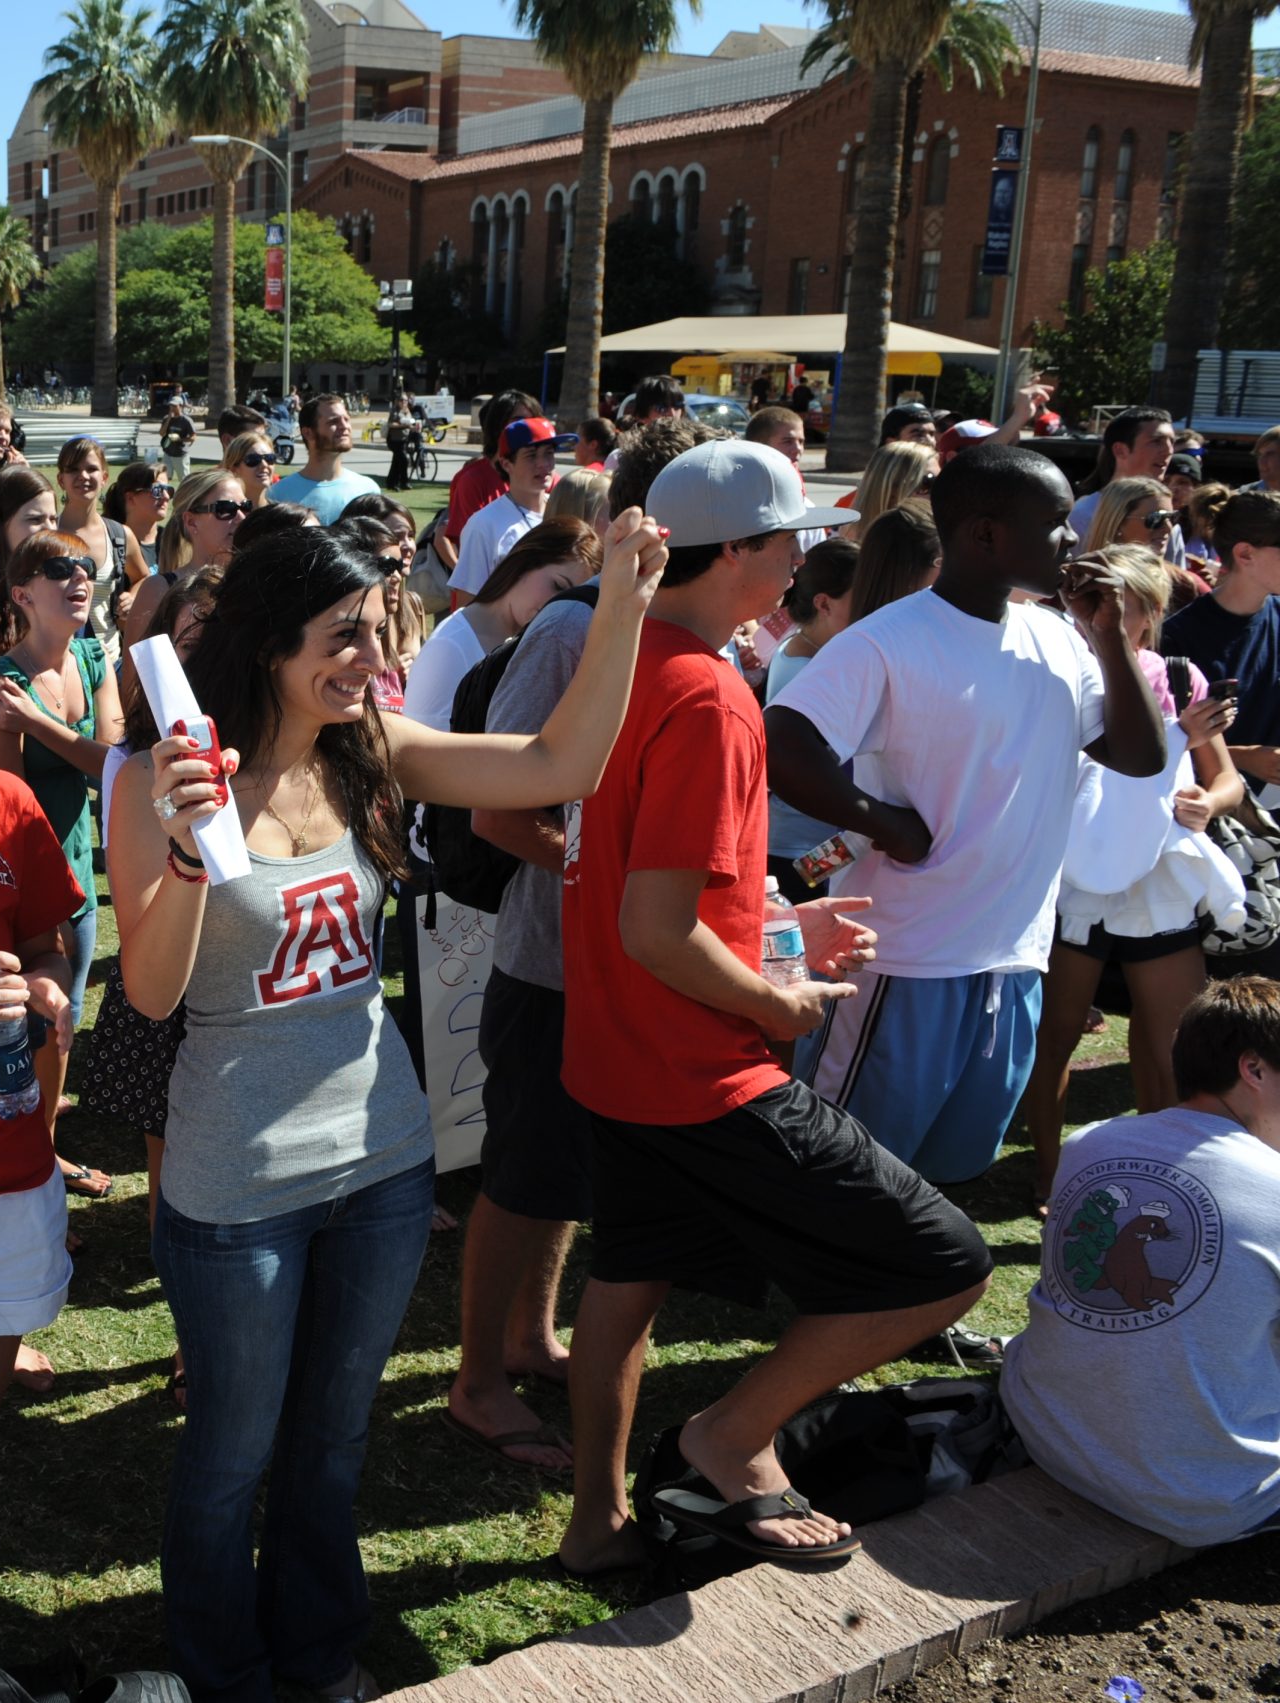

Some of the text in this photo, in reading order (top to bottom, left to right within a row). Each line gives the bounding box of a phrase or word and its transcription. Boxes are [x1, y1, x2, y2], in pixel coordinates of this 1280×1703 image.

[1077, 1161, 1182, 1184] UNDERWATER
[1180, 1178, 1221, 1268] DEMOLITION
[1069, 1306, 1171, 1329] TRAINING
